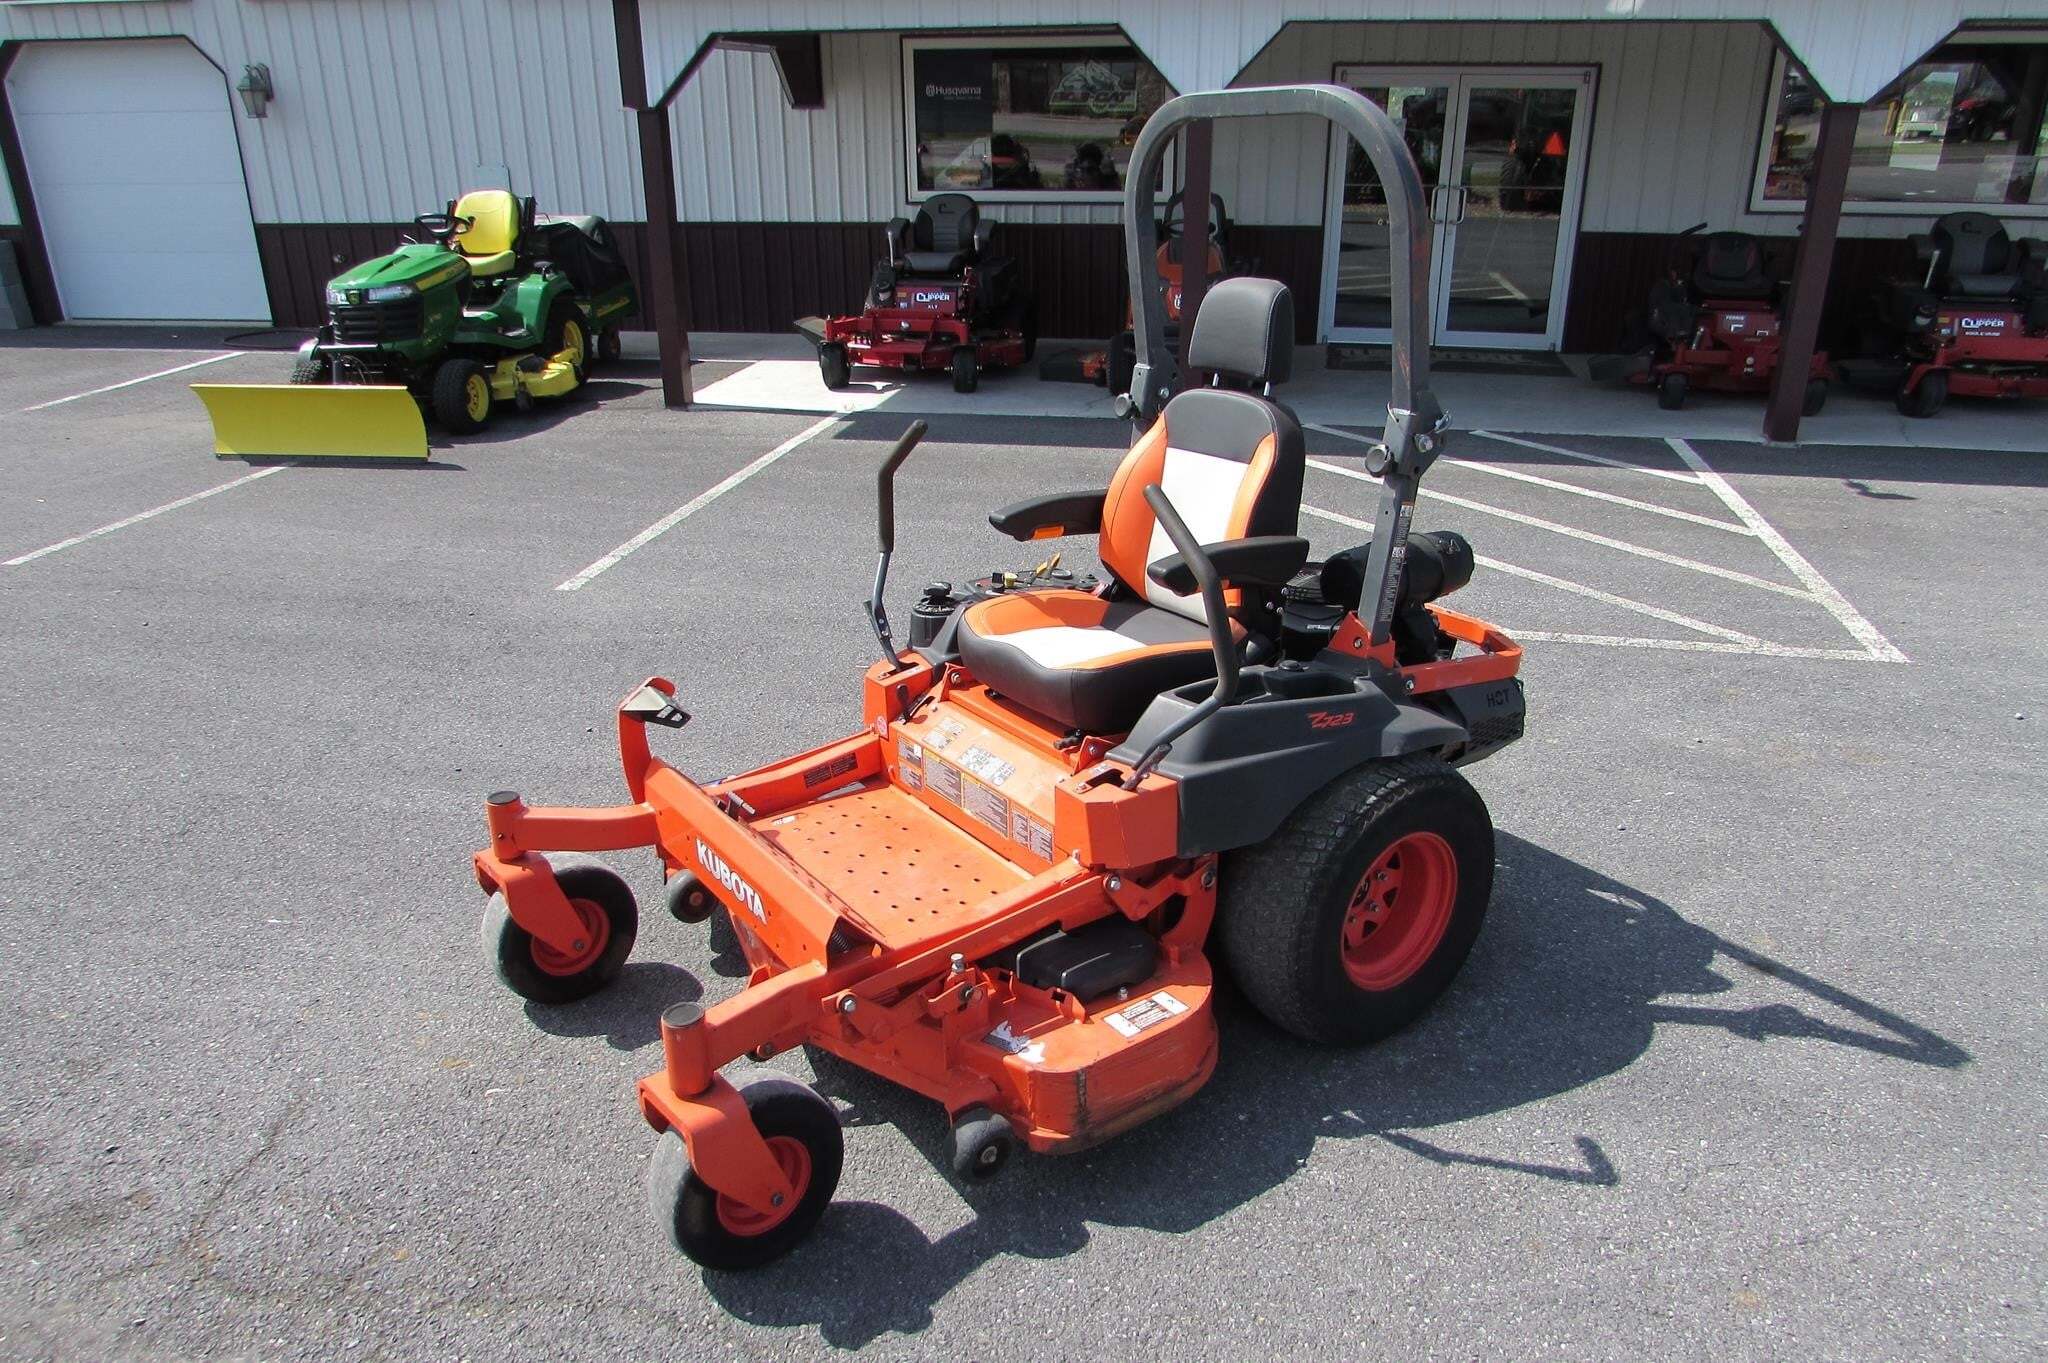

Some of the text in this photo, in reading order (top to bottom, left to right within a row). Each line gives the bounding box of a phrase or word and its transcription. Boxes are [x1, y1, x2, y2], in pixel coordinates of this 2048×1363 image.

[935, 86, 982, 96] Husqvarna
[916, 292, 950, 302] CLIPPER
[1961, 318, 2005, 329] CLIPPER
[1486, 687, 1510, 708] HOT
[696, 836, 767, 925] KUBOTA
